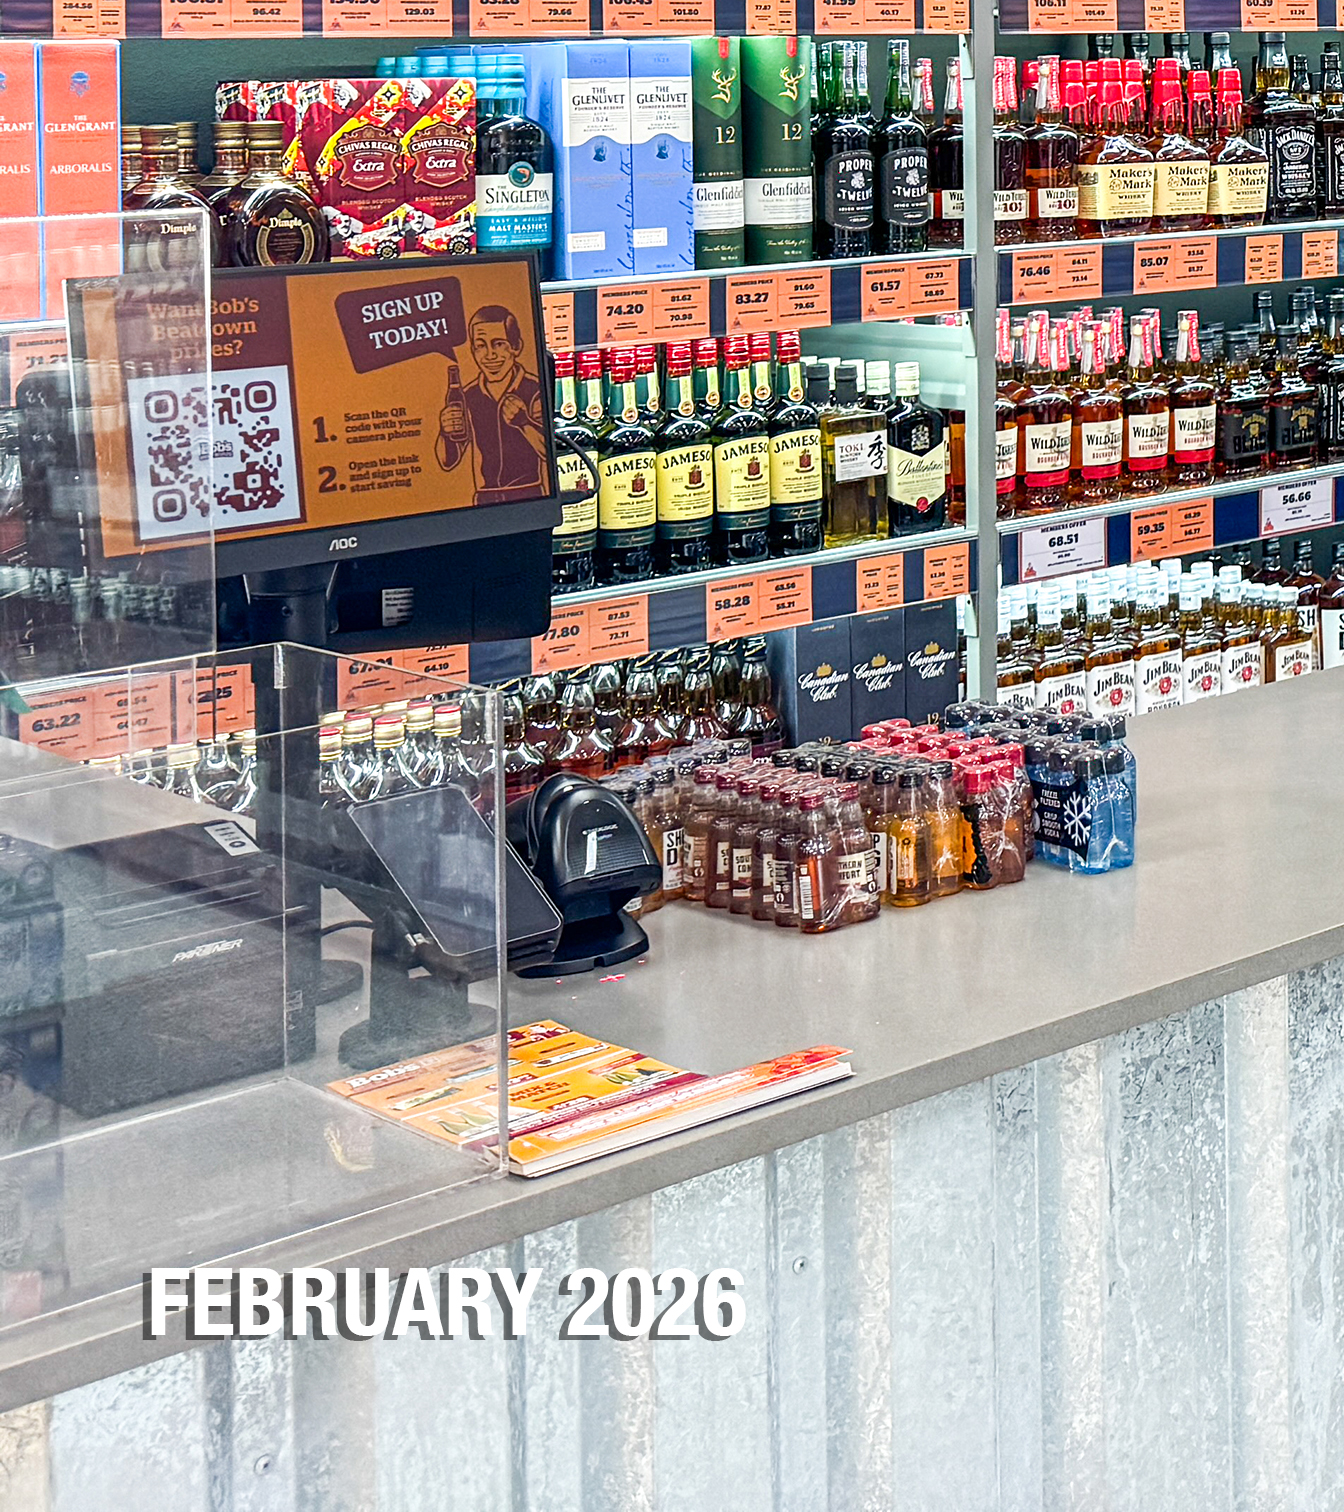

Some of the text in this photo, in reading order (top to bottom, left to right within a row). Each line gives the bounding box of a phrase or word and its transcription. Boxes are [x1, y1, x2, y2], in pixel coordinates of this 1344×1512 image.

[45, 120, 116, 133] GLENGRANT
[781, 123, 802, 142] 12
[338, 142, 398, 155] CHIVAS REGAL
[485, 188, 550, 205] SINGLETON
[735, 293, 769, 305] 83.27
[147, 303, 203, 319] Want
[361, 291, 444, 324] SIGN UP
[606, 304, 644, 316] 74.20
[369, 318, 449, 351] TODAY!
[313, 407, 406, 443] 1. Scan the QR
[345, 418, 422, 433] code with your
[346, 429, 421, 444] camera phone
[318, 454, 419, 493] 2. Open the link
[350, 465, 421, 481] and sign up to
[350, 478, 412, 493] start saving
[1048, 533, 1079, 548] 68.51
